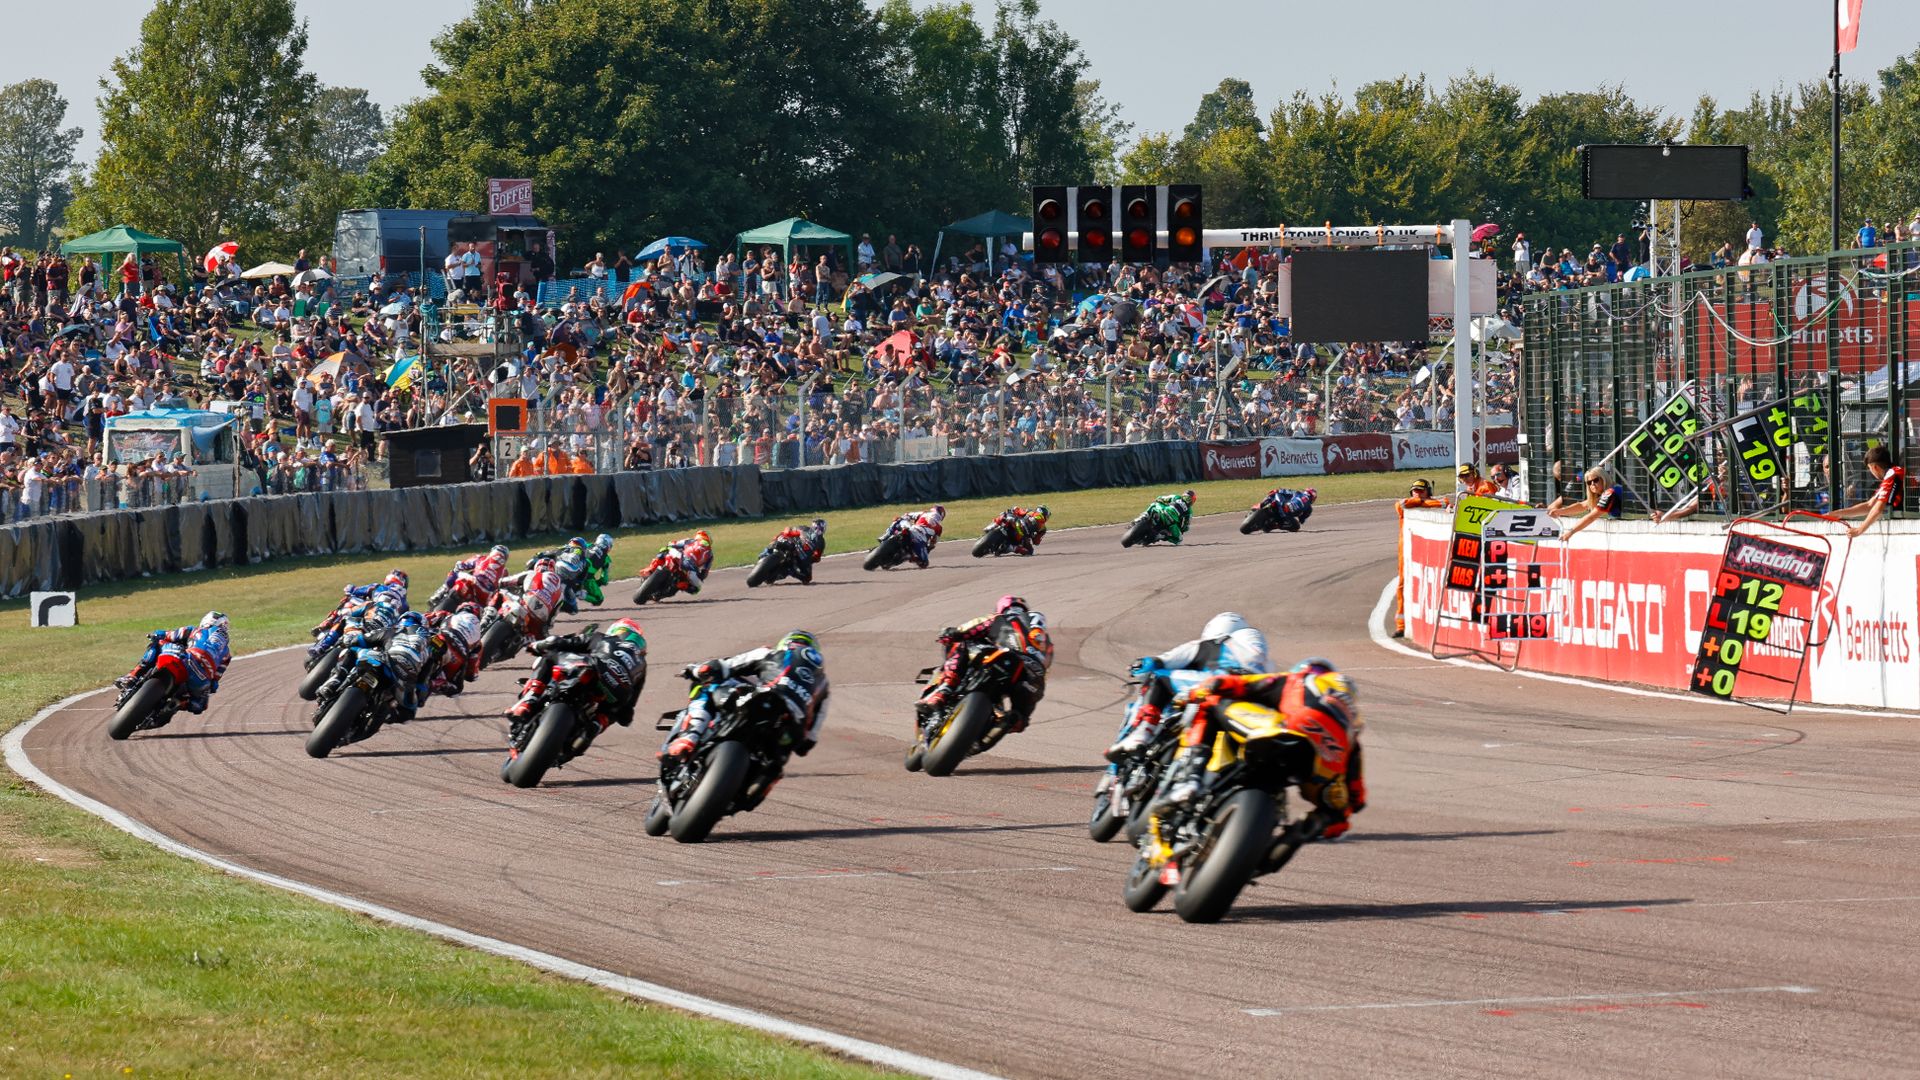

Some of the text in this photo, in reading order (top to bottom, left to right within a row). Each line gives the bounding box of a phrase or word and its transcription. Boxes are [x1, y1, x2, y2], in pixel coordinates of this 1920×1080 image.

[491, 185, 530, 212] COFFEE
[1791, 326, 1873, 344] ennetts
[505, 442, 512, 457] 2
[1280, 451, 1319, 465] Bennetts
[1346, 447, 1389, 462] Bennetts
[1415, 444, 1450, 459] Bennetts
[1220, 454, 1257, 470] Bennetts
[1509, 515, 1537, 533] 2
[1456, 537, 1480, 559] KEN
[1490, 541, 1507, 563] P
[1737, 545, 1814, 579] Redding
[1451, 566, 1474, 587] HAS
[1846, 605, 1910, 664] Bennetts
